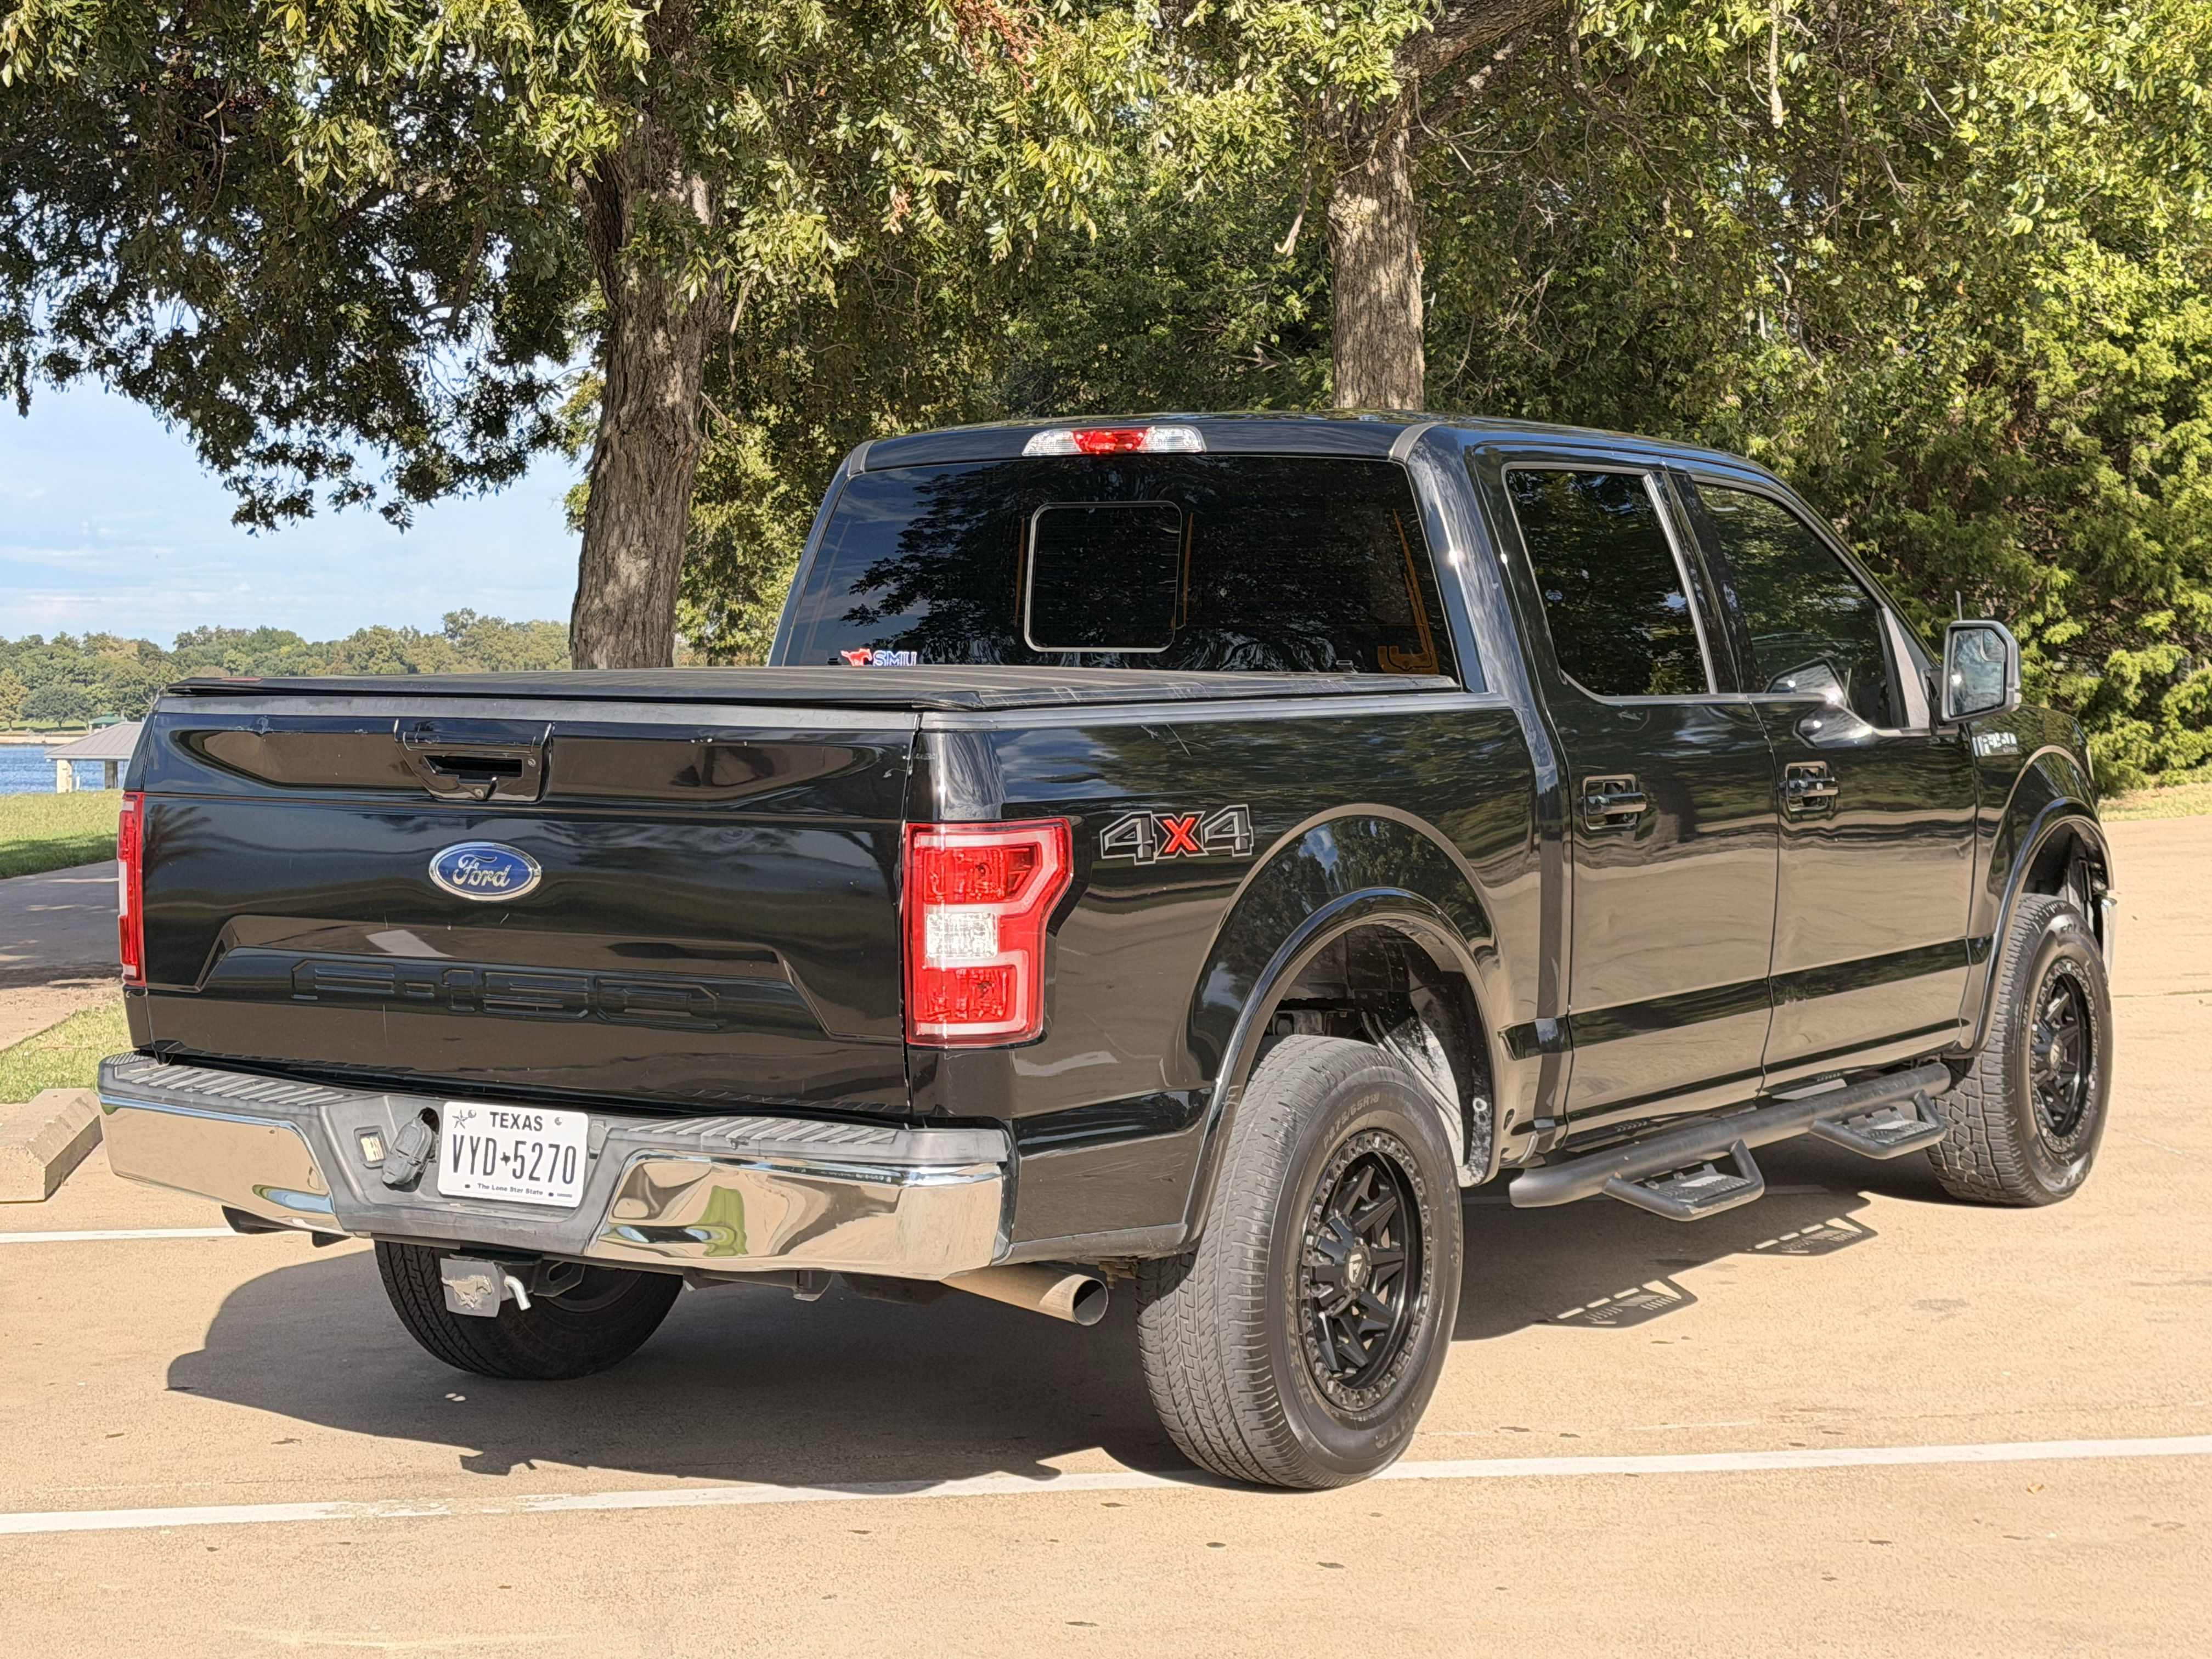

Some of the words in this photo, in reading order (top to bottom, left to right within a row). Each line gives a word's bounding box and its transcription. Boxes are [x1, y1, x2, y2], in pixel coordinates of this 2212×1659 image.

[873, 650, 917, 667] SMU
[453, 854, 512, 887] Ford
[489, 1111, 543, 1132] TEXAS
